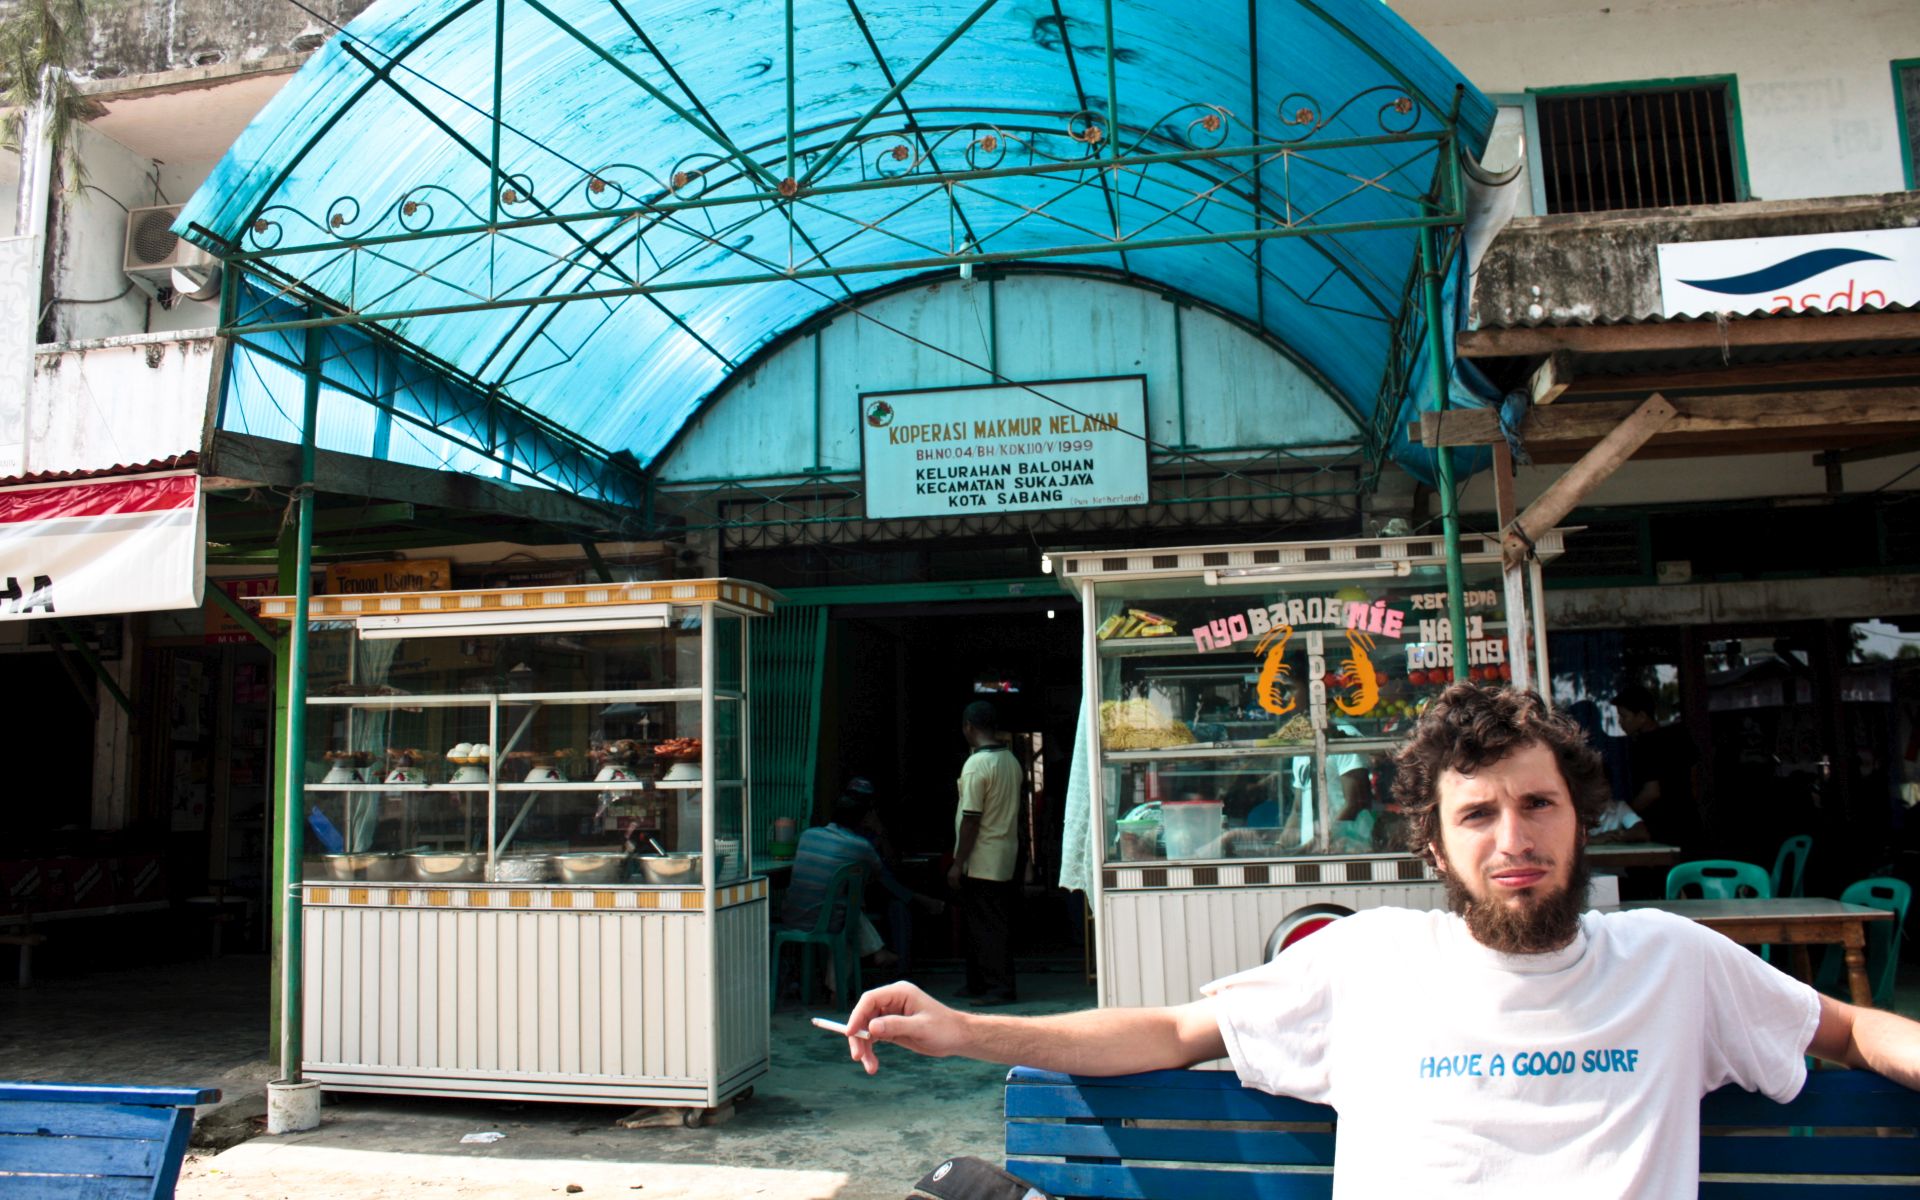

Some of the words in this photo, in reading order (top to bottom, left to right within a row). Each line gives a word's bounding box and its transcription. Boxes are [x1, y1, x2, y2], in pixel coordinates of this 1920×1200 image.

[889, 421, 967, 445] KOPERASI
[974, 417, 1042, 440] MAKMUR
[1049, 412, 1119, 434] NELAYAN
[916, 462, 1012, 480] KELURAHAN
[1018, 459, 1094, 475] BALOHAN
[916, 478, 1005, 495] KECAMATAN
[1014, 473, 1094, 489] SUKAJAYA
[949, 495, 987, 507] KOTA
[997, 490, 1062, 505] SABANG
[430, 571, 441, 589] 2
[1419, 616, 1484, 641] NAI
[1419, 1054, 1483, 1078] HAVE
[1489, 1053, 1505, 1076] A
[1511, 1051, 1576, 1076] GOOD
[1581, 1049, 1639, 1073] SURF
